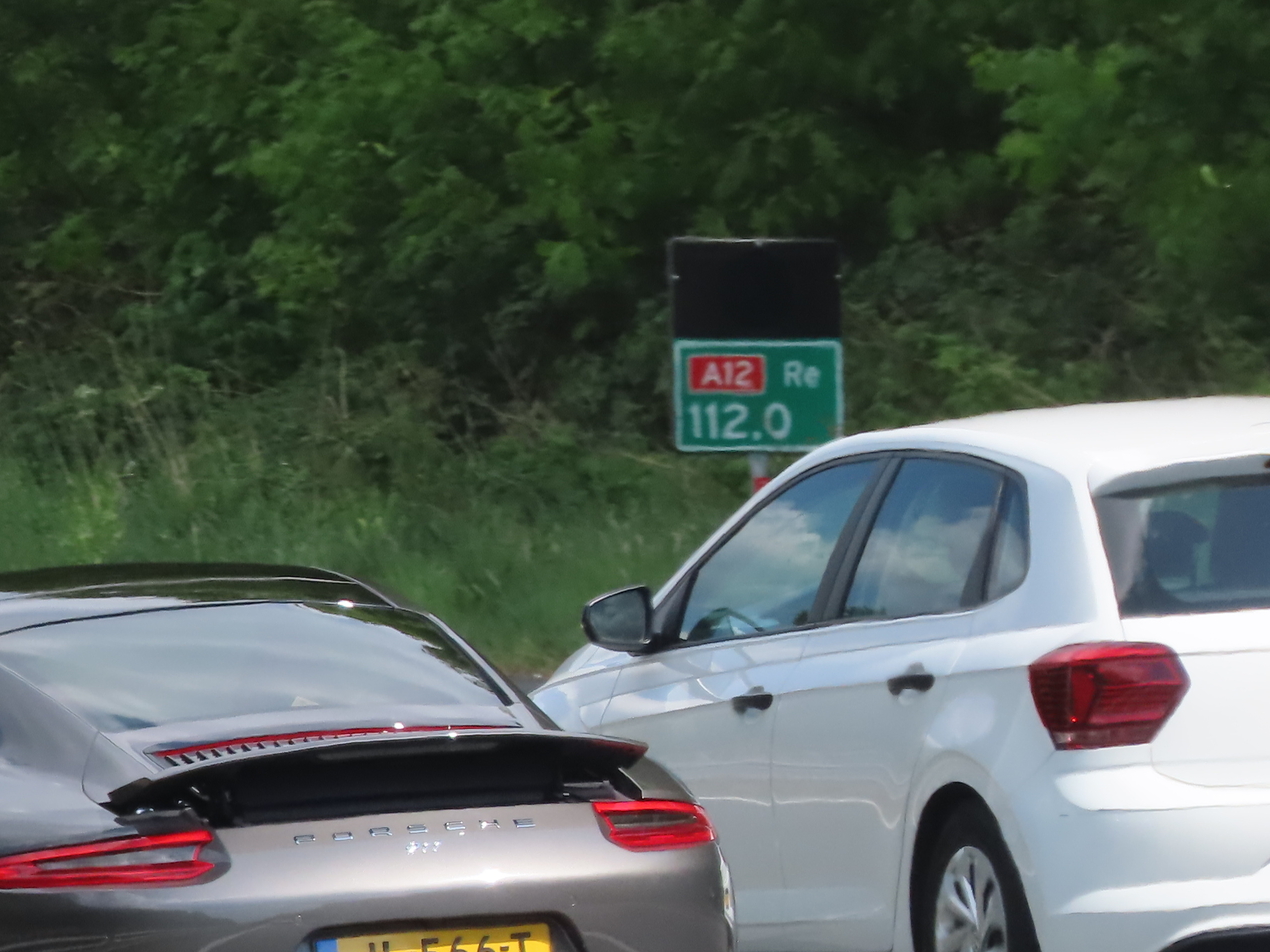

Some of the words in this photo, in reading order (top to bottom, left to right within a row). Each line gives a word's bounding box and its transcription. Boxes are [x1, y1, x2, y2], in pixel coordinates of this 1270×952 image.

[701, 361, 754, 387] A12
[783, 360, 821, 389] Re
[688, 402, 792, 441] 112.0
[293, 818, 536, 845] PORSCHE
